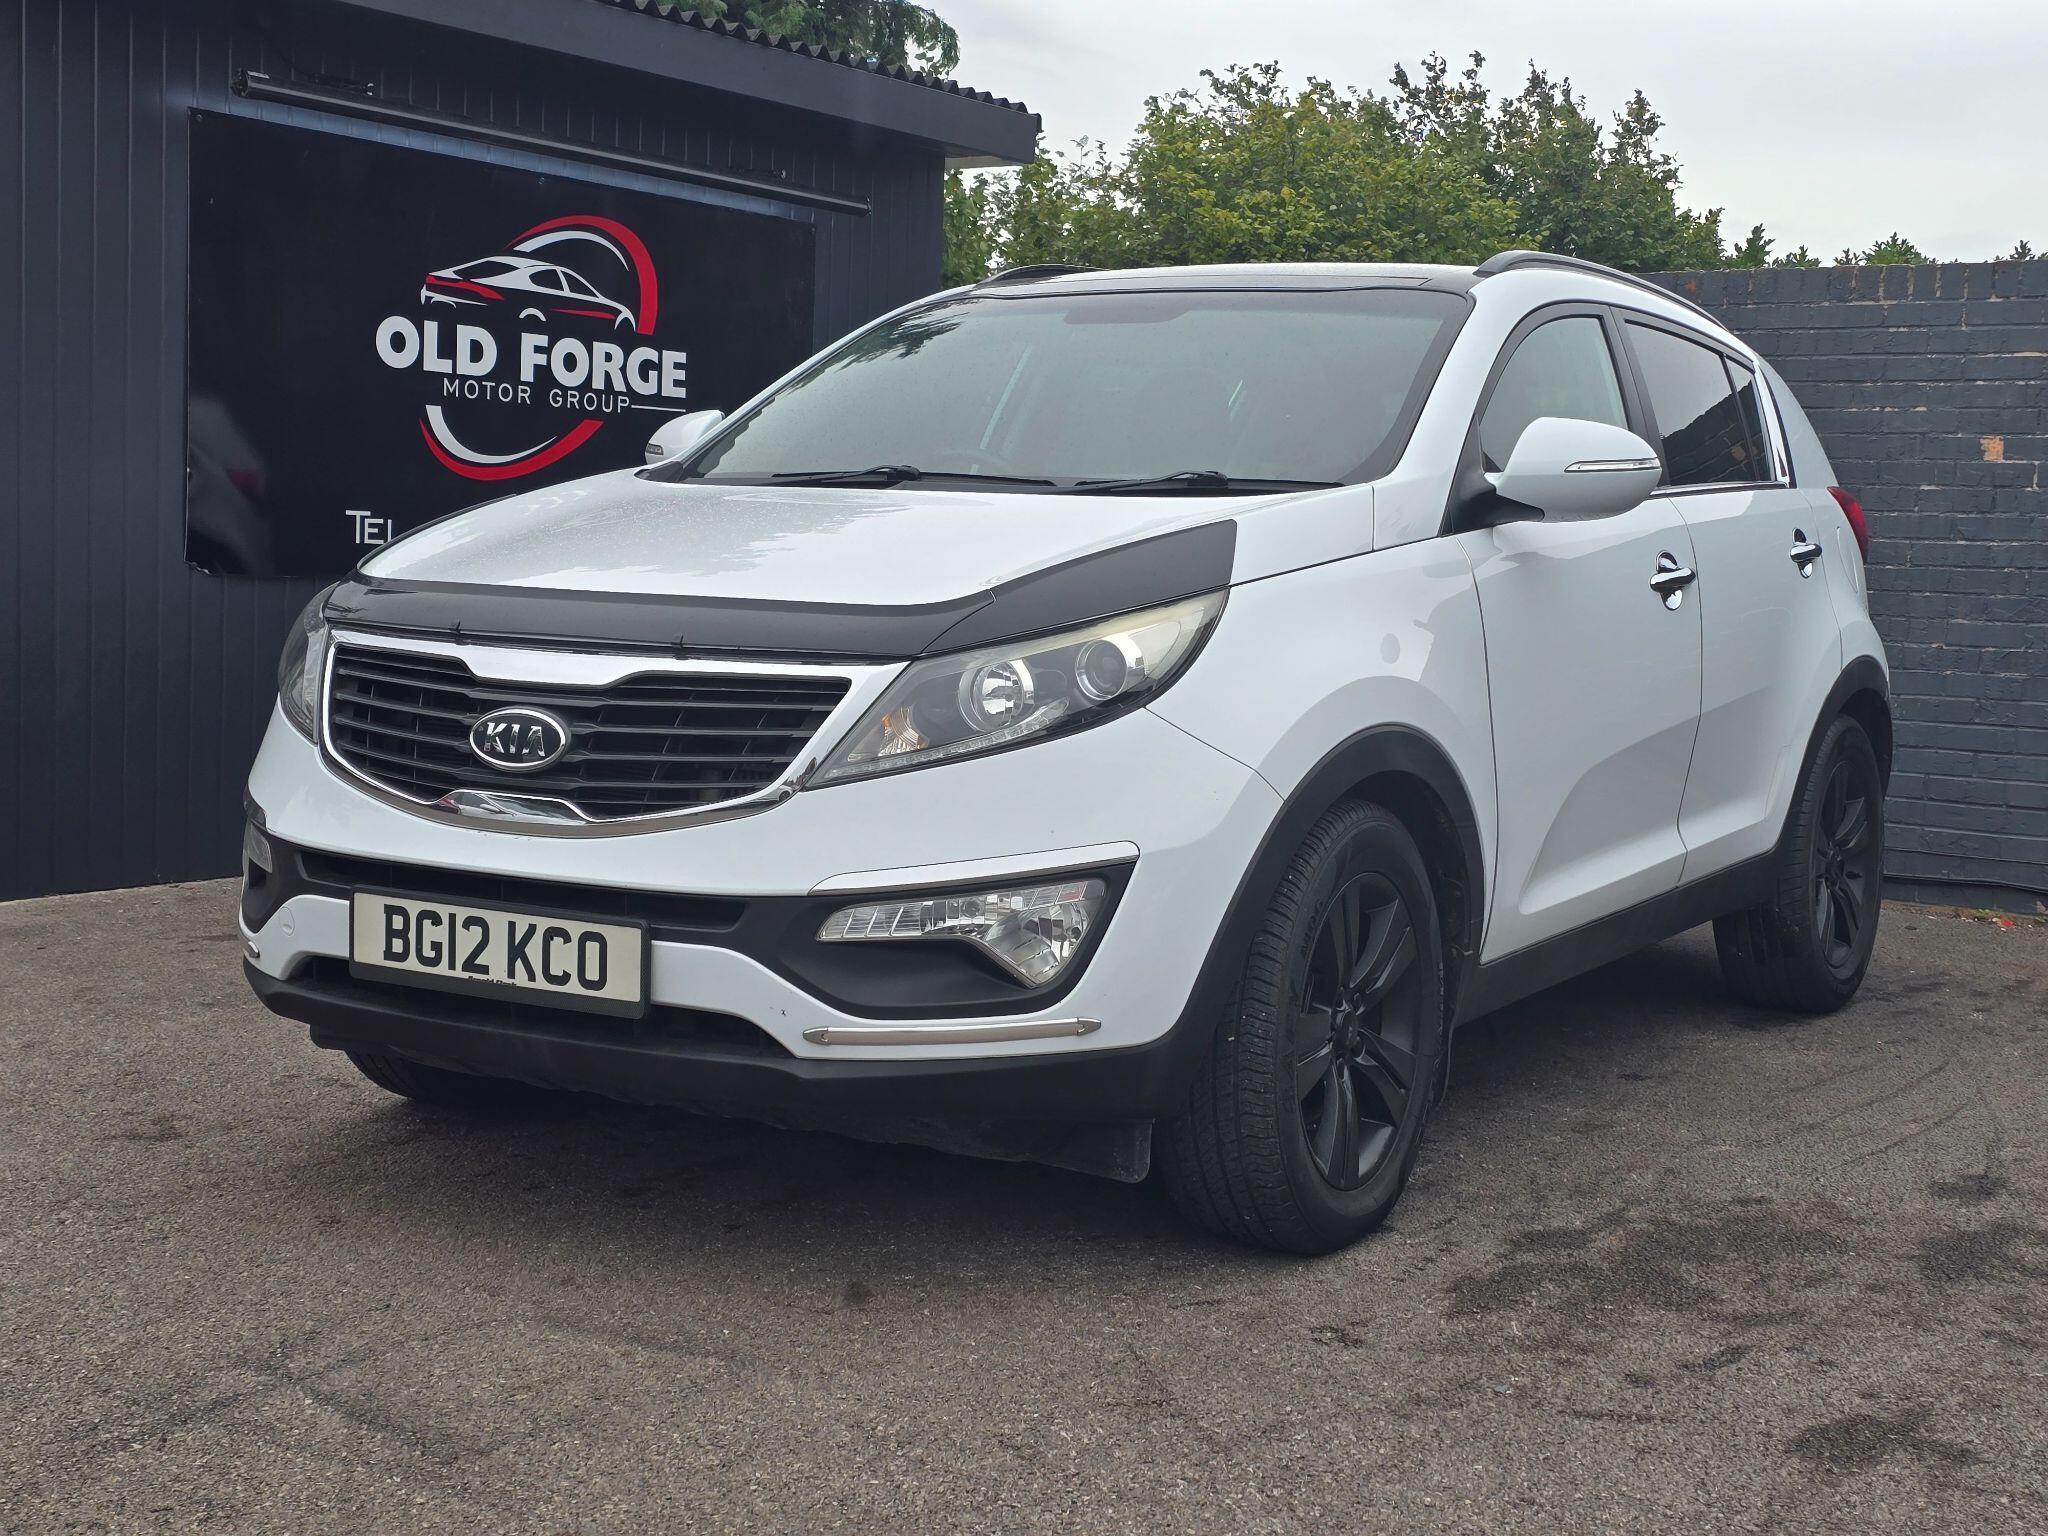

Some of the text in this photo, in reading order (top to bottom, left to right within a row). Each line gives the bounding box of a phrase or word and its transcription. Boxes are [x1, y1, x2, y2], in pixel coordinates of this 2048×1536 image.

[376, 315, 687, 398] OLD FORGE
[443, 378, 630, 413] MOTOR GROUP
[484, 721, 546, 757] KIA
[383, 904, 608, 992] BG12 KCO
